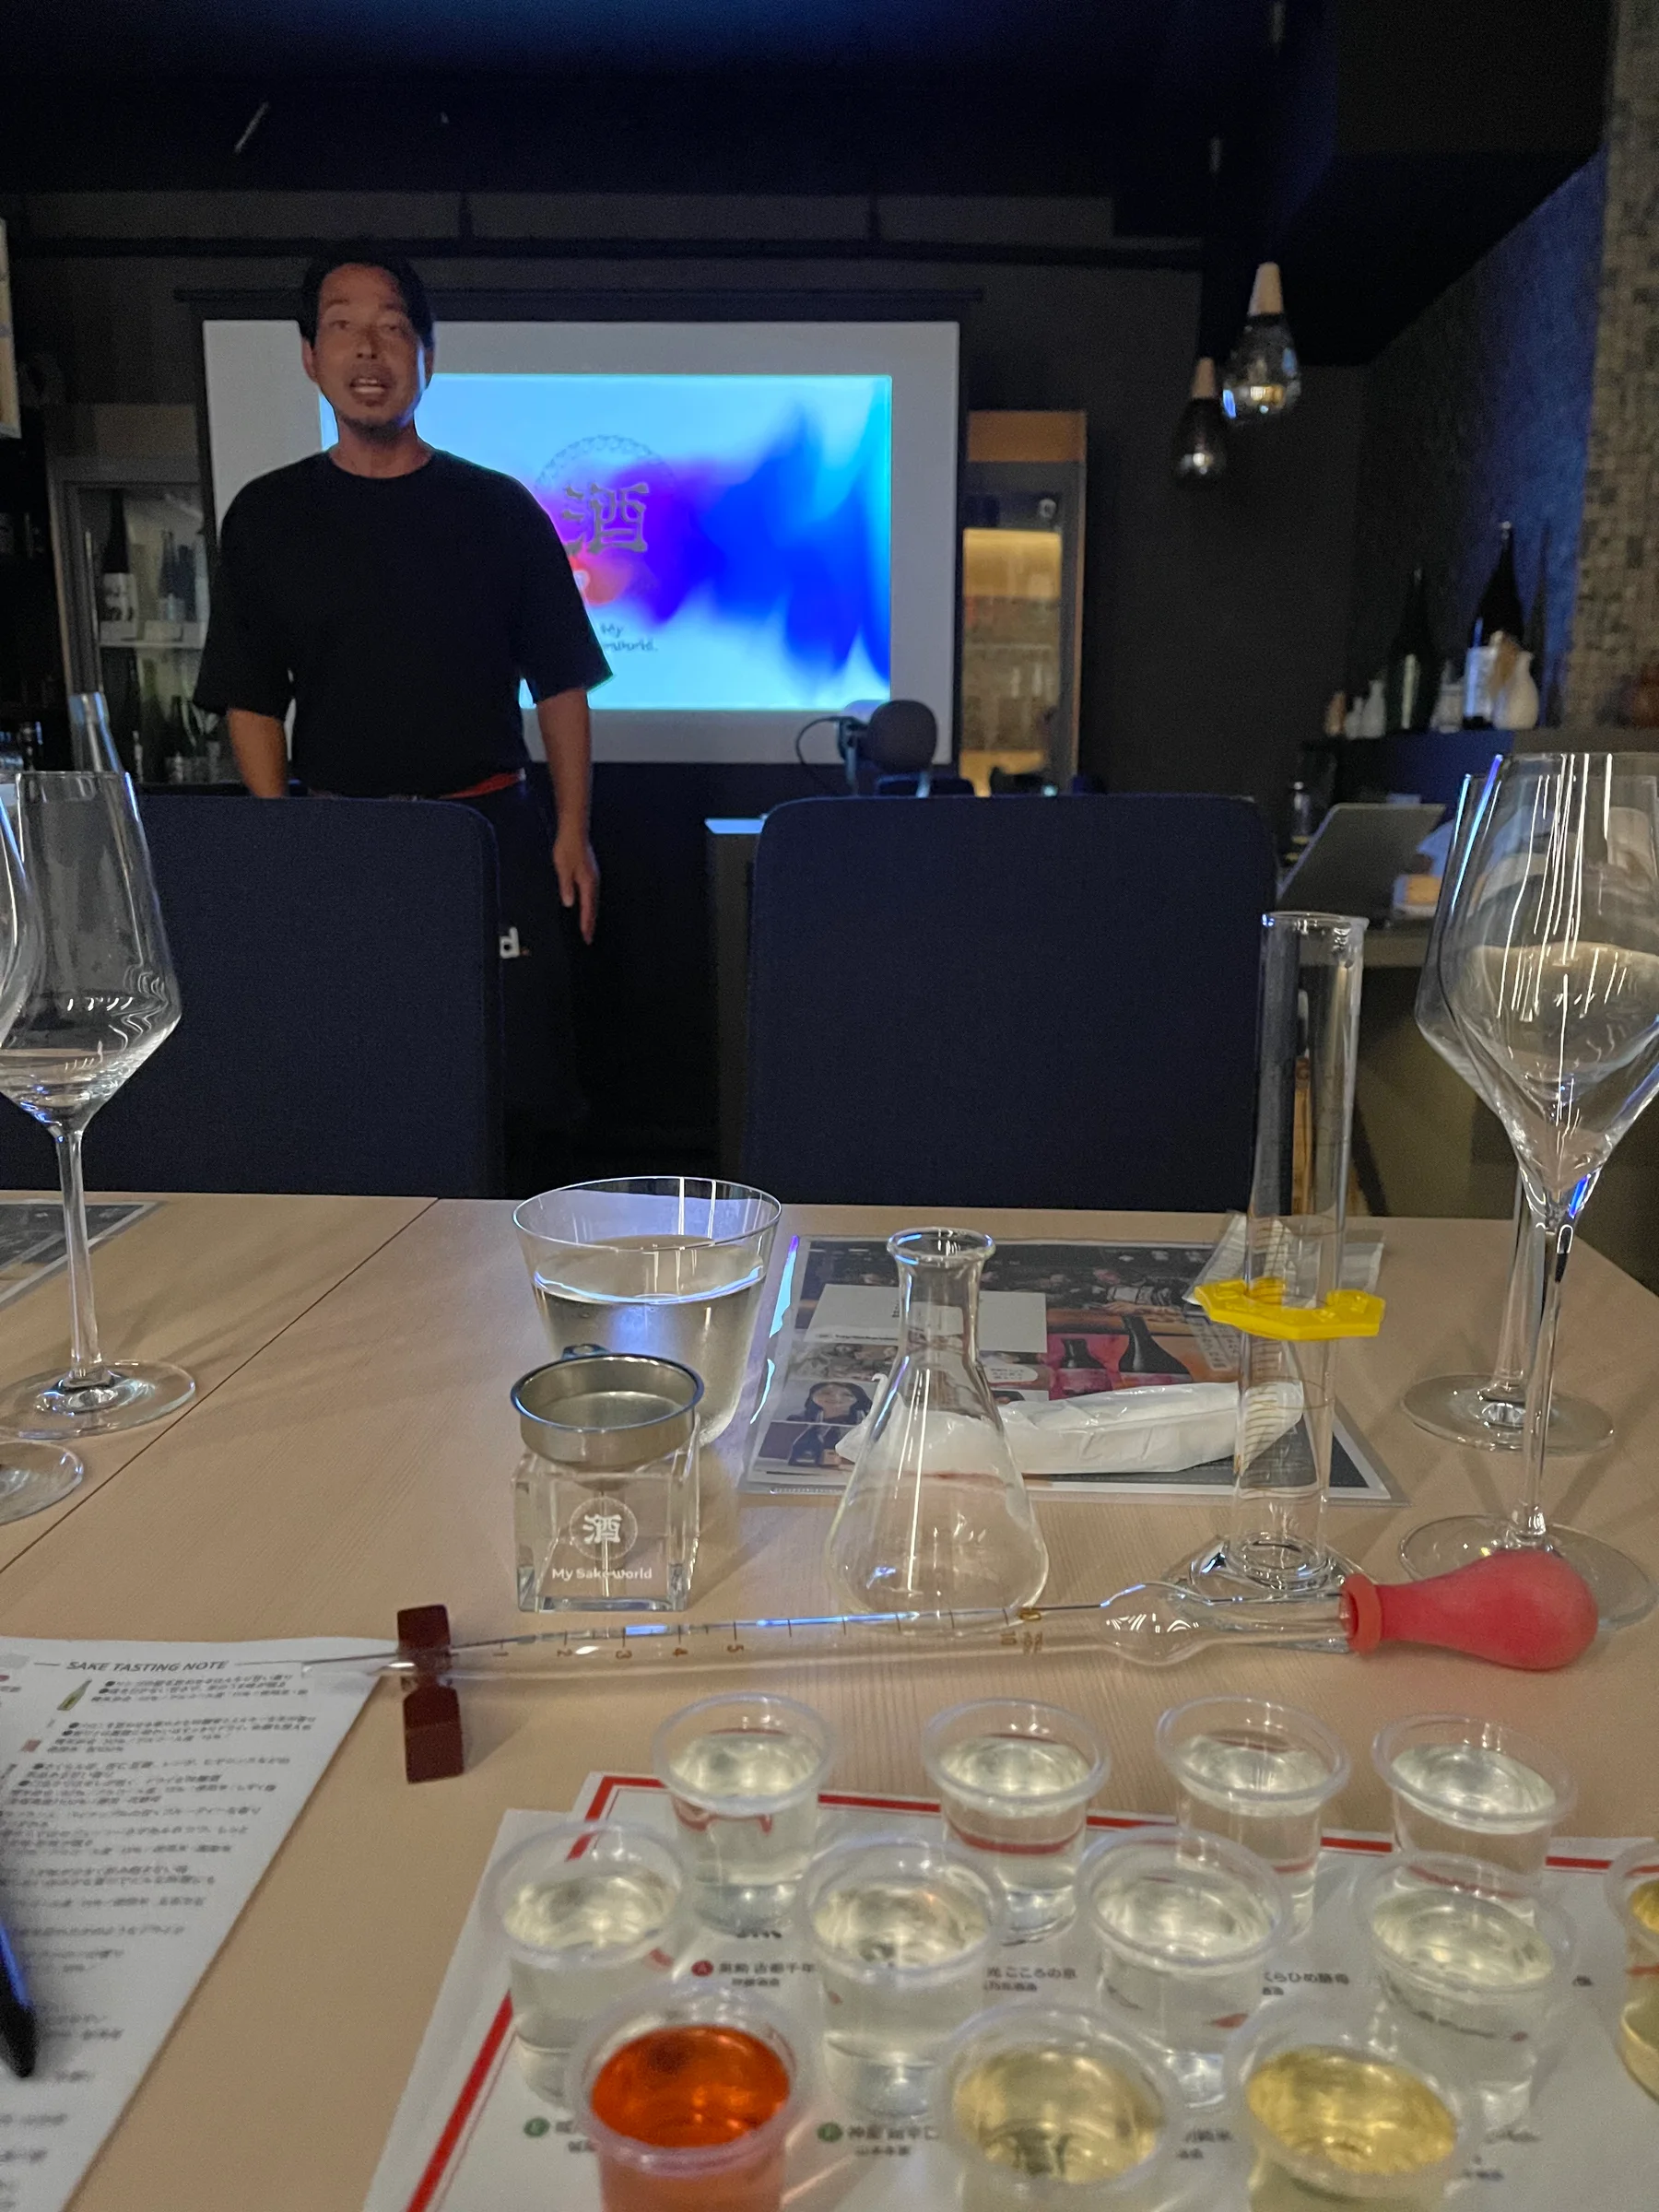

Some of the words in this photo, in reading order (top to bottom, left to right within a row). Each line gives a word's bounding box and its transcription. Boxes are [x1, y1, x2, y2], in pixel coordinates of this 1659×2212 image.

[561, 481, 650, 555] 酒
[582, 1513, 622, 1545] 酒
[552, 1568, 573, 1582] My
[615, 1649, 632, 1659] 3
[66, 1661, 110, 1671] SAKE
[112, 1662, 180, 1672] TASTING
[182, 1660, 229, 1671] NOTE
